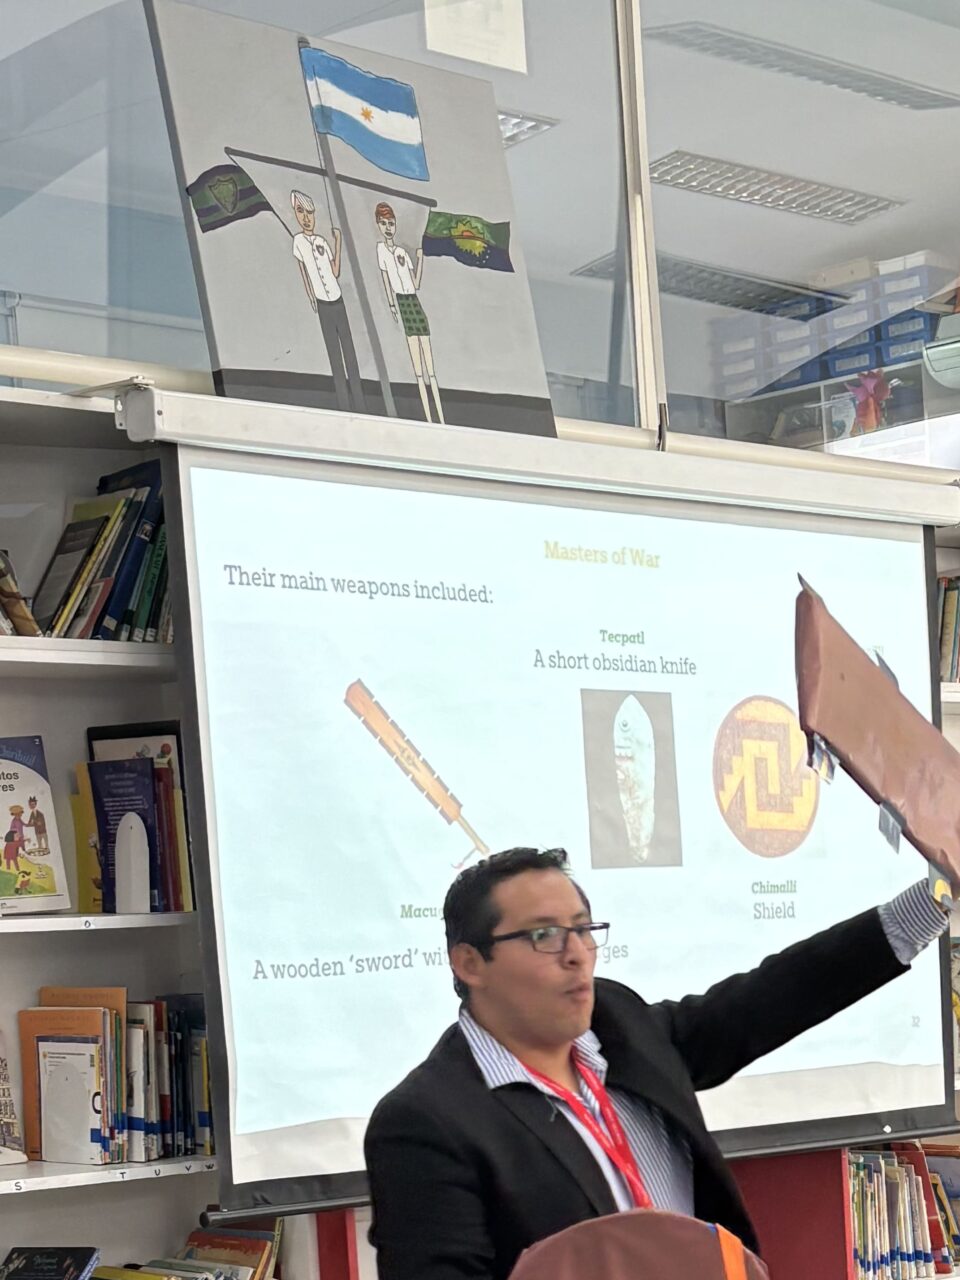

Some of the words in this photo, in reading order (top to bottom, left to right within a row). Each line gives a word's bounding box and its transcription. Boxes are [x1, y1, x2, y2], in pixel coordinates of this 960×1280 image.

[545, 541, 608, 564] Masters
[612, 547, 627, 565] of
[630, 549, 660, 568] War
[224, 564, 276, 587] Their
[280, 571, 327, 592] main
[331, 577, 411, 600] weapons
[414, 580, 494, 603] included:
[600, 629, 645, 647] Tecpatl
[533, 649, 546, 668] A
[548, 650, 589, 670] short
[593, 653, 657, 674] obsidian
[660, 657, 697, 676] knife
[751, 880, 797, 895] Chimalli
[753, 901, 796, 920] Shield
[252, 959, 268, 980] A
[271, 955, 345, 980] wooden
[14, 1181, 22, 1191] S
[119, 1171, 127, 1180] T
[154, 1168, 161, 1177] U
[185, 1164, 192, 1172] V
